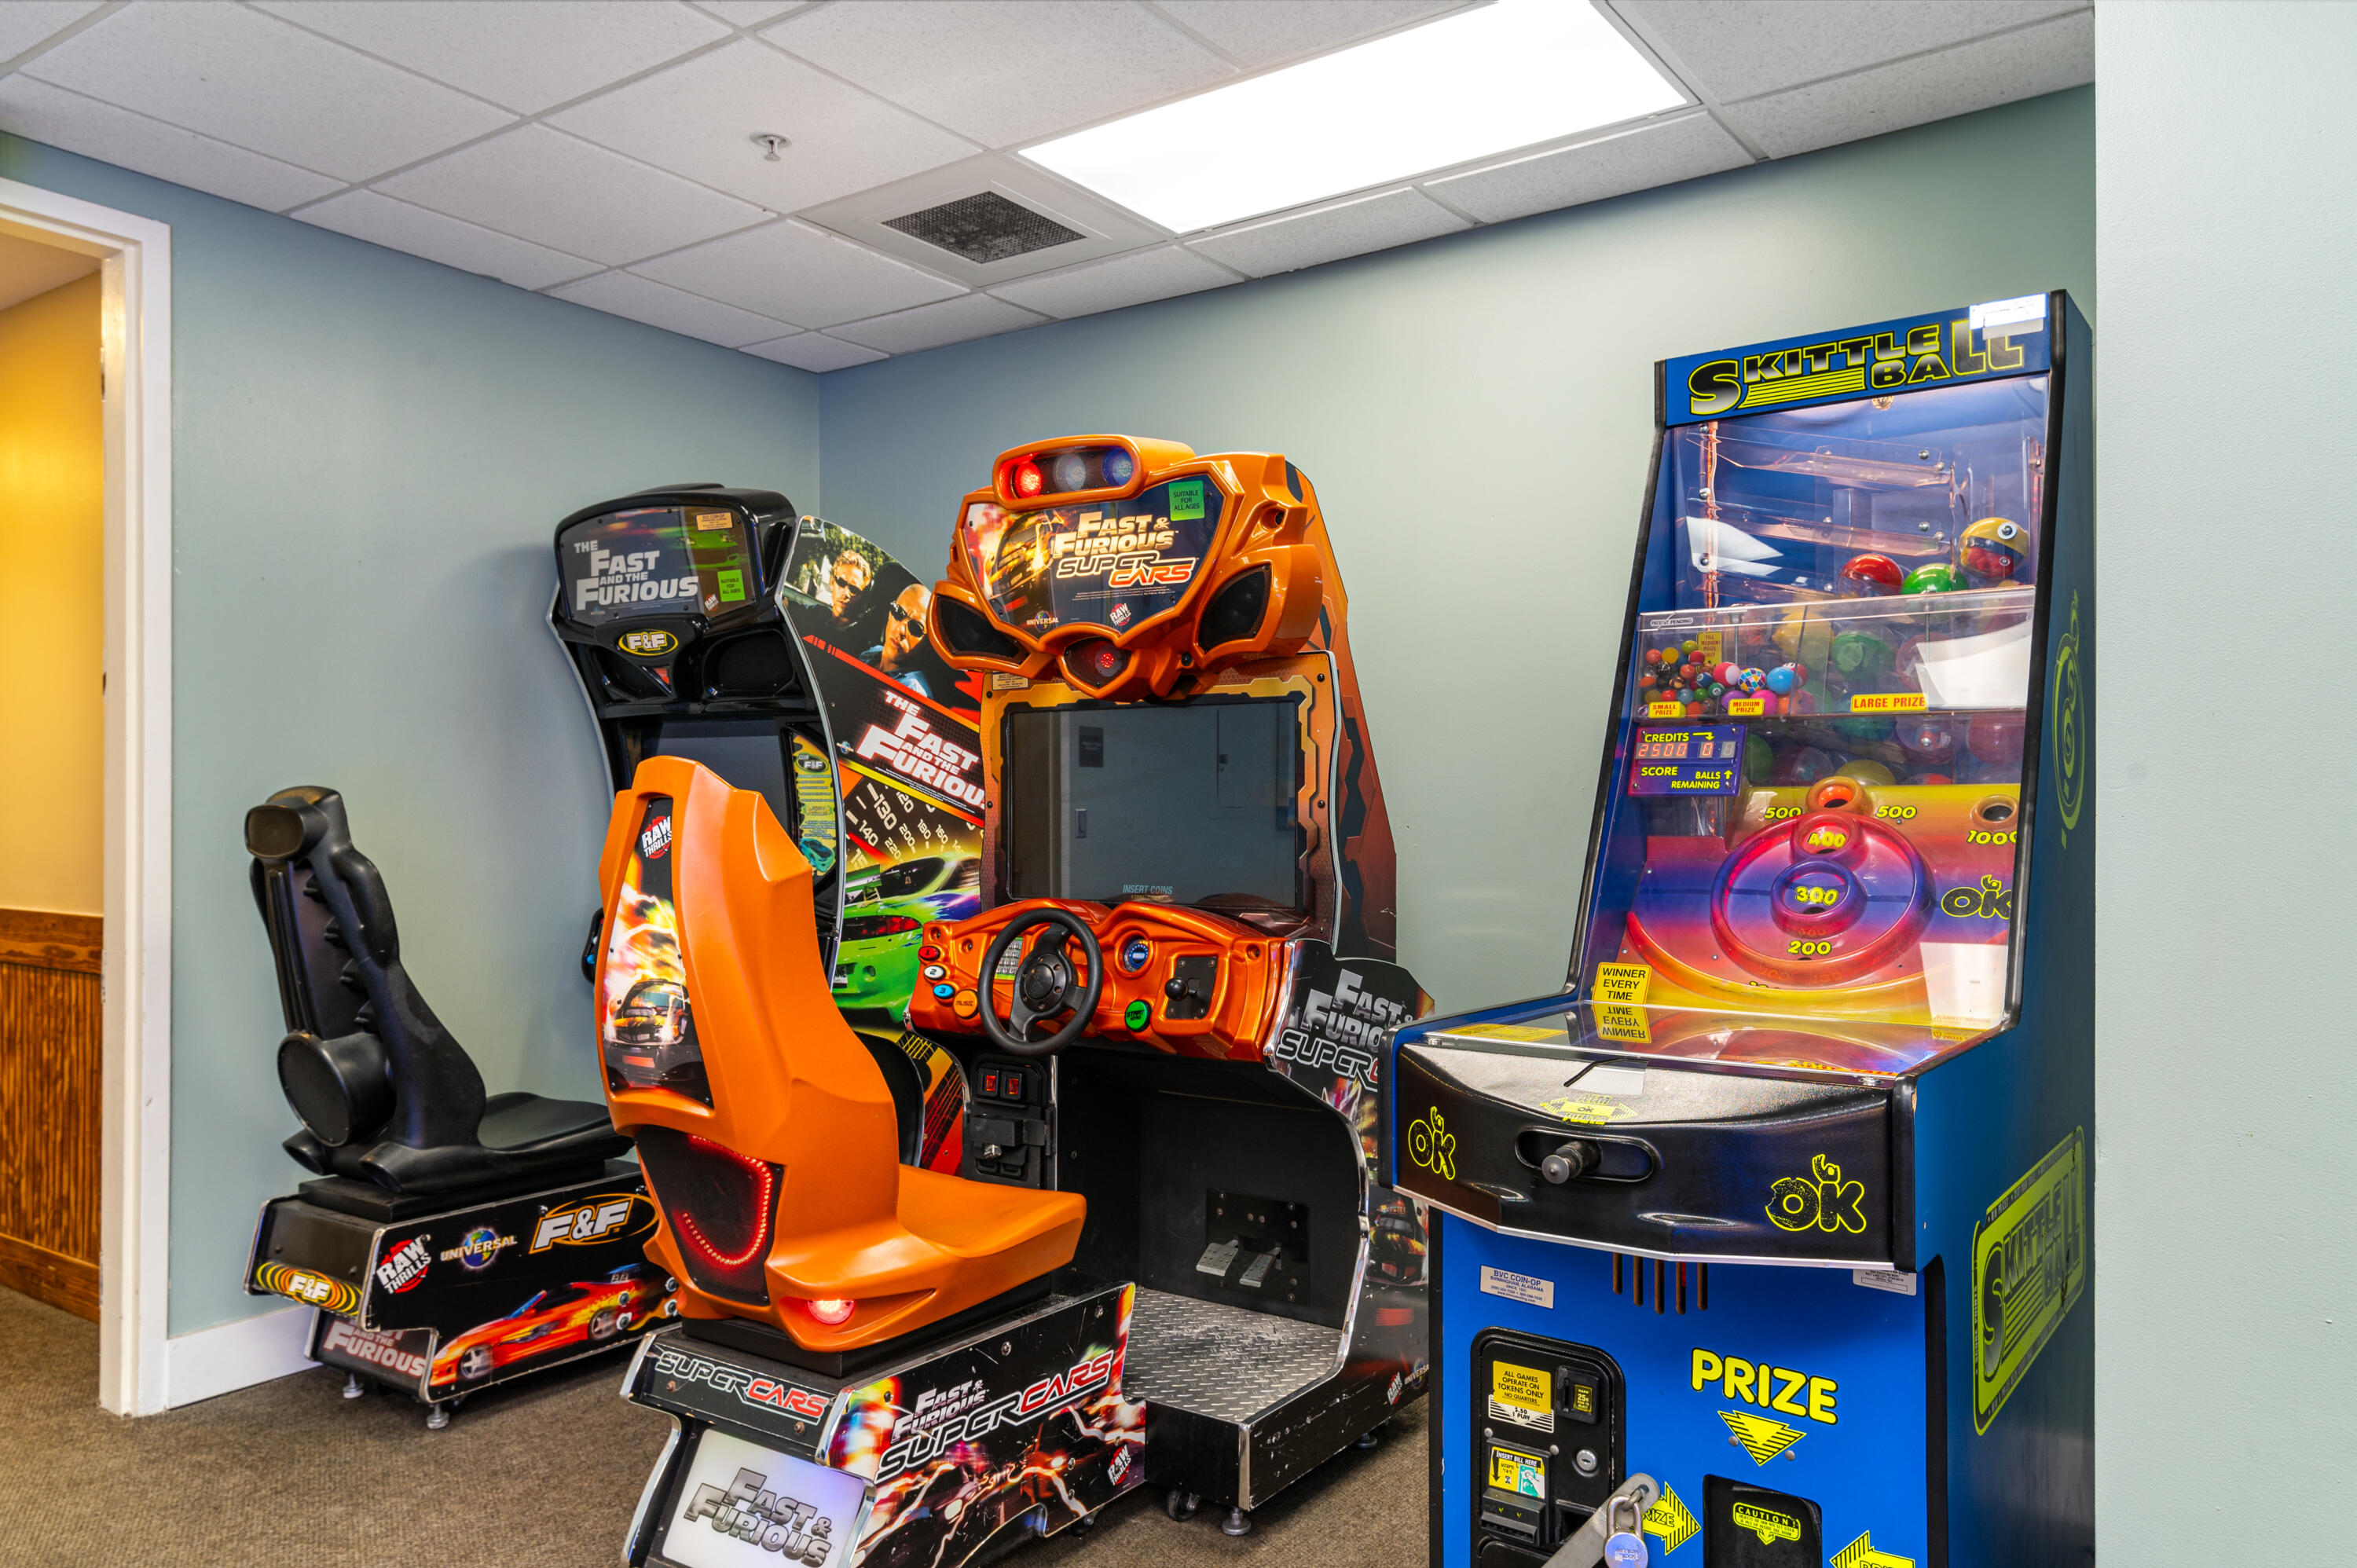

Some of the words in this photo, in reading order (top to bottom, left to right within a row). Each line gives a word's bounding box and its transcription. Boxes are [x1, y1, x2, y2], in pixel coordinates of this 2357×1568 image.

[1871, 319, 2024, 390] BALL
[1688, 324, 1941, 415] SKITTLE
[1076, 511, 1153, 539] FAST
[1153, 516, 1171, 531] &
[574, 540, 599, 553] THE
[1052, 530, 1175, 559] FURIOUS
[591, 549, 660, 577] FAST
[1056, 550, 1180, 579] SUPER
[1109, 563, 1193, 588] CARS
[599, 574, 623, 586] AND
[625, 571, 649, 582] THE
[576, 576, 699, 611] FURIOUS
[1026, 617, 1060, 625] UNIVERSAL
[1109, 603, 1131, 621] RAW
[628, 633, 666, 650] F&F
[884, 691, 921, 716] THE
[1853, 697, 1890, 710] LARGE
[1891, 694, 1926, 708] PRIZE
[895, 713, 979, 771] FAST
[1638, 743, 1688, 757] 2500
[1701, 742, 1714, 757] 0
[1644, 732, 1689, 742] CREDITS
[856, 724, 985, 809] FURIOU
[901, 743, 933, 763] AND
[934, 756, 961, 775] THE
[1640, 767, 1678, 776] SCORE
[1670, 781, 1721, 789] REMAINING
[874, 793, 897, 830] 130
[1765, 806, 1802, 820] 500
[1875, 805, 1917, 819] 500
[641, 816, 672, 848] RAW
[859, 819, 878, 847] 140
[899, 823, 916, 847] 200
[917, 819, 931, 840] 180
[935, 824, 948, 844] 160
[1807, 832, 1846, 848] 400
[643, 830, 673, 858] THRILLS
[884, 837, 902, 860] 220
[1122, 885, 1149, 894] INSERT
[1150, 885, 1173, 895] COINS
[1795, 886, 1838, 905] 300
[1787, 940, 1832, 955] 200
[1603, 967, 1646, 978] WINNER
[1603, 979, 1640, 989] EVERY
[1332, 969, 1402, 1027] FAST
[1607, 991, 1633, 1000] TIME
[1408, 1106, 1456, 1180] OK
[1765, 1153, 1868, 1234] OK
[534, 1200, 630, 1249] F&F
[376, 1236, 428, 1285] RAW
[440, 1236, 519, 1262] UNIVERSAL
[384, 1252, 431, 1294] THRILLS
[1494, 1269, 1508, 1279] BVC
[1510, 1273, 1541, 1286] COIN-OP
[1982, 1180, 2062, 1383] SKITTLE
[288, 1273, 332, 1300] F&F
[1521, 1283, 1544, 1292] ALABAMA
[323, 1321, 427, 1377] FURIOUS
[352, 1328, 375, 1341] AND
[375, 1334, 394, 1347] THE
[654, 1350, 830, 1425] SUPERCARS
[1502, 1377, 1528, 1387] OPERATE
[1516, 1372, 1538, 1383] GAMES
[1691, 1347, 1838, 1425] PRIZE
[915, 1379, 973, 1418] FAST
[973, 1379, 984, 1394] &
[1497, 1383, 1524, 1394] TOKENS
[1526, 1388, 1544, 1398] ONLY
[1513, 1394, 1538, 1404] QUARTERS
[874, 1349, 1115, 1482] SUPERCARS
[890, 1390, 986, 1445] FURIOUS
[1108, 1445, 1129, 1482] RAW
[1496, 1450, 1513, 1461] INSERT
[1514, 1455, 1524, 1464] BILL
[1525, 1458, 1538, 1467] HERE
[723, 1467, 818, 1531] FAST
[811, 1516, 833, 1540] &
[684, 1482, 832, 1568] FURIOUS
[1738, 1506, 1796, 1528] CAUTION!
